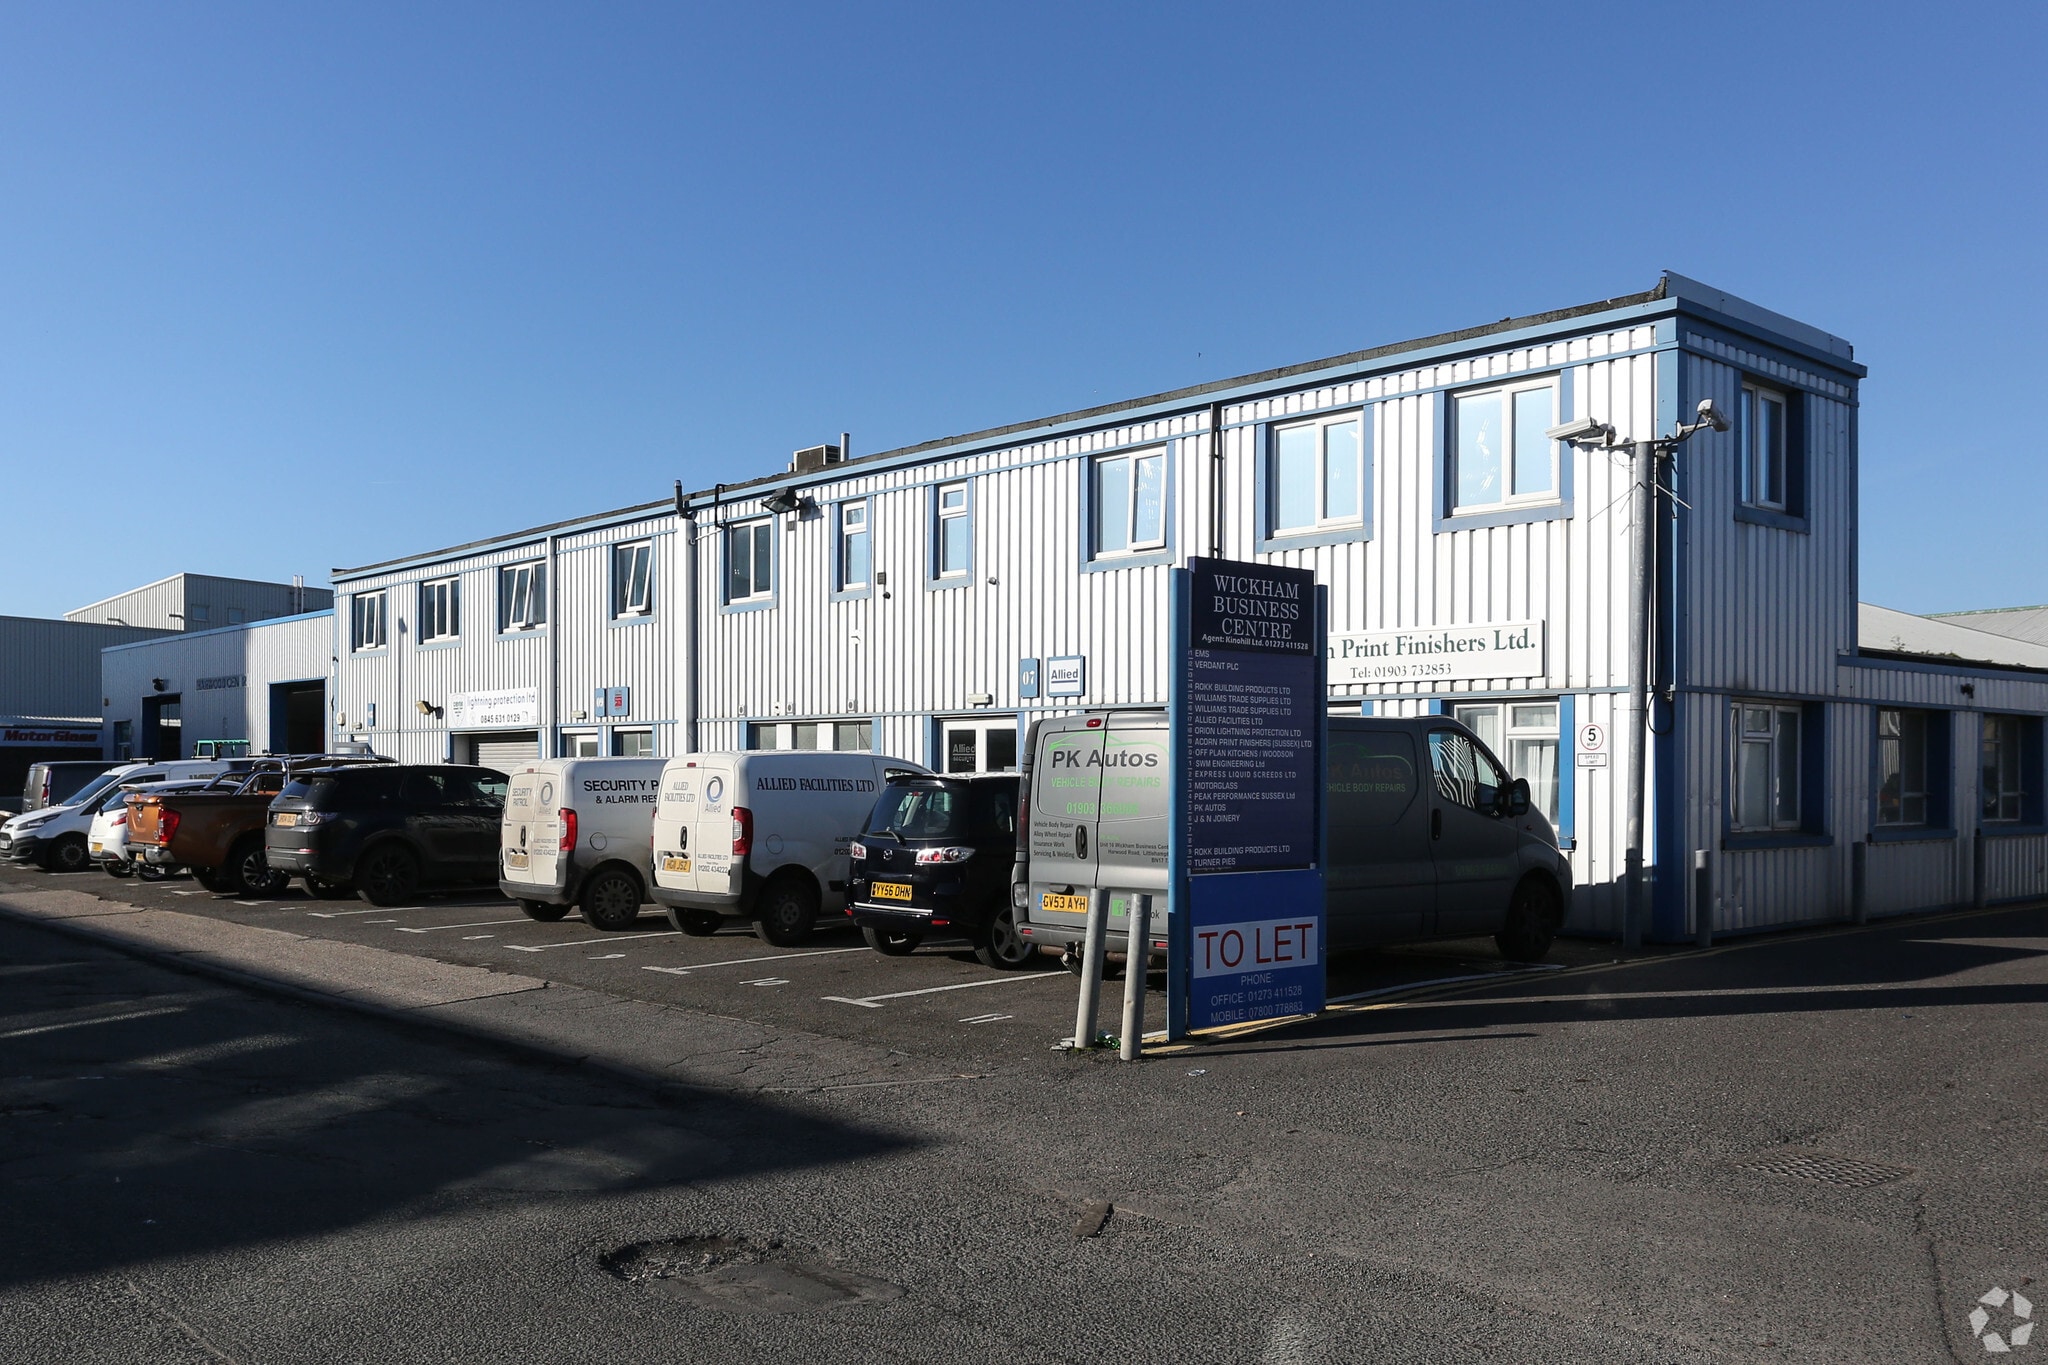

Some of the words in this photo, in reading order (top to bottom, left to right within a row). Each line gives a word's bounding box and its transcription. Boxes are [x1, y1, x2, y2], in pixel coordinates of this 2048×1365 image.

[1214, 574, 1300, 600] WICKHAM
[1214, 596, 1299, 620] BUSINESS
[1222, 618, 1292, 640] CENTRE
[1202, 633, 1225, 644] Agent:
[1265, 640, 1285, 648] 01273
[1286, 641, 1309, 650] 411528
[1341, 638, 1390, 659] Print
[1395, 632, 1486, 656] Finishers
[1493, 628, 1536, 650] Ltd.
[1195, 650, 1210, 658] EMS
[1195, 661, 1225, 670] VERDANT
[1226, 662, 1239, 670] PLC
[1350, 666, 1371, 679] Tel:
[1374, 664, 1407, 678] 01903
[1411, 663, 1452, 676] 732853
[1022, 670, 1035, 685] 07
[1051, 668, 1078, 679] Allied
[1195, 683, 1213, 691] ROKK
[1215, 683, 1244, 693] BUILDING
[1245, 684, 1278, 694] PRODUCTS
[1279, 686, 1290, 695] LTD
[494, 693, 525, 708] protection
[526, 691, 536, 703] ltd
[1195, 694, 1227, 702] WILLIAMS
[1228, 695, 1248, 703] TRADE
[1250, 696, 1278, 704] SUPPLIES
[1280, 697, 1292, 705] LTD
[1195, 705, 1227, 713] WILLIAMS
[1228, 706, 1248, 714] TRADE
[1250, 706, 1278, 715] SUPPLIES
[1280, 708, 1292, 716] LTD
[480, 715, 494, 723] 0845
[495, 714, 505, 723] 631
[507, 714, 520, 722] 0129
[1195, 716, 1216, 724] ALLIED
[1218, 717, 1250, 725] FACILITIES
[1251, 718, 1263, 726] LTD
[4, 730, 98, 742] MotorGlass
[1194, 727, 1216, 735] ORION
[1217, 727, 1251, 736] LIGHTNING
[1252, 728, 1289, 737] PROTECTION
[1290, 729, 1302, 737] LTD
[1588, 728, 1596, 742] 5
[953, 744, 976, 753] Allied
[1195, 738, 1218, 746] ACORN
[1220, 738, 1238, 746] PRINT
[1240, 739, 1271, 747] FINISHERS
[1301, 740, 1312, 748] LTD
[1052, 750, 1082, 768] PK
[1086, 750, 1158, 768] Autos
[1227, 750, 1258, 758] KITCHENS
[1262, 750, 1294, 758] WOODSON
[1212, 760, 1254, 768] ENGINEERING
[1256, 760, 1265, 768] Ltd
[584, 780, 646, 791] SECURITY
[672, 782, 689, 790] ALLIED
[756, 777, 796, 791] ALLIED
[800, 778, 853, 792] FACILITIES
[856, 780, 874, 792] LTD
[1051, 777, 1086, 788] VEHICLE
[1118, 777, 1160, 787] REPAIRS
[1194, 782, 1238, 790] MOTORGLASS
[1327, 783, 1351, 792] HICLE
[1353, 783, 1374, 792] BODY
[1376, 783, 1406, 793] REPAIRS
[512, 788, 532, 796] SECURITY
[664, 793, 686, 802] FACILITIES
[686, 794, 695, 802] LTD
[1194, 792, 1212, 800] PEAK
[1213, 792, 1260, 800] PERFORMANCE
[596, 796, 602, 804] &
[606, 795, 639, 803] ALARM
[642, 795, 657, 803] RES
[705, 804, 721, 813] Allied
[1066, 802, 1095, 814] 01903
[1194, 804, 1203, 812] PK
[1060, 821, 1074, 829] Repair
[1033, 850, 1051, 858] Servicing
[1057, 851, 1075, 859] Welding
[1194, 848, 1212, 856] ROKK
[1214, 847, 1243, 855] BUILDING
[1245, 846, 1277, 854] PRODUCTS
[1194, 858, 1221, 867] TURNER
[1222, 858, 1236, 866] PIES
[876, 884, 894, 896] YY56
[895, 886, 911, 898] OHN
[1043, 896, 1065, 908] GV53
[1067, 898, 1086, 910] AYH
[1198, 929, 1244, 970] TO
[1256, 923, 1313, 964] LET
[1241, 972, 1274, 986] PHONE:
[1211, 993, 1247, 1007] OFFICE:
[1248, 989, 1272, 1001] 01273
[1274, 986, 1302, 997] 411528
[1210, 1009, 1247, 1023] MOBILE:
[1249, 1005, 1273, 1018] 07800
